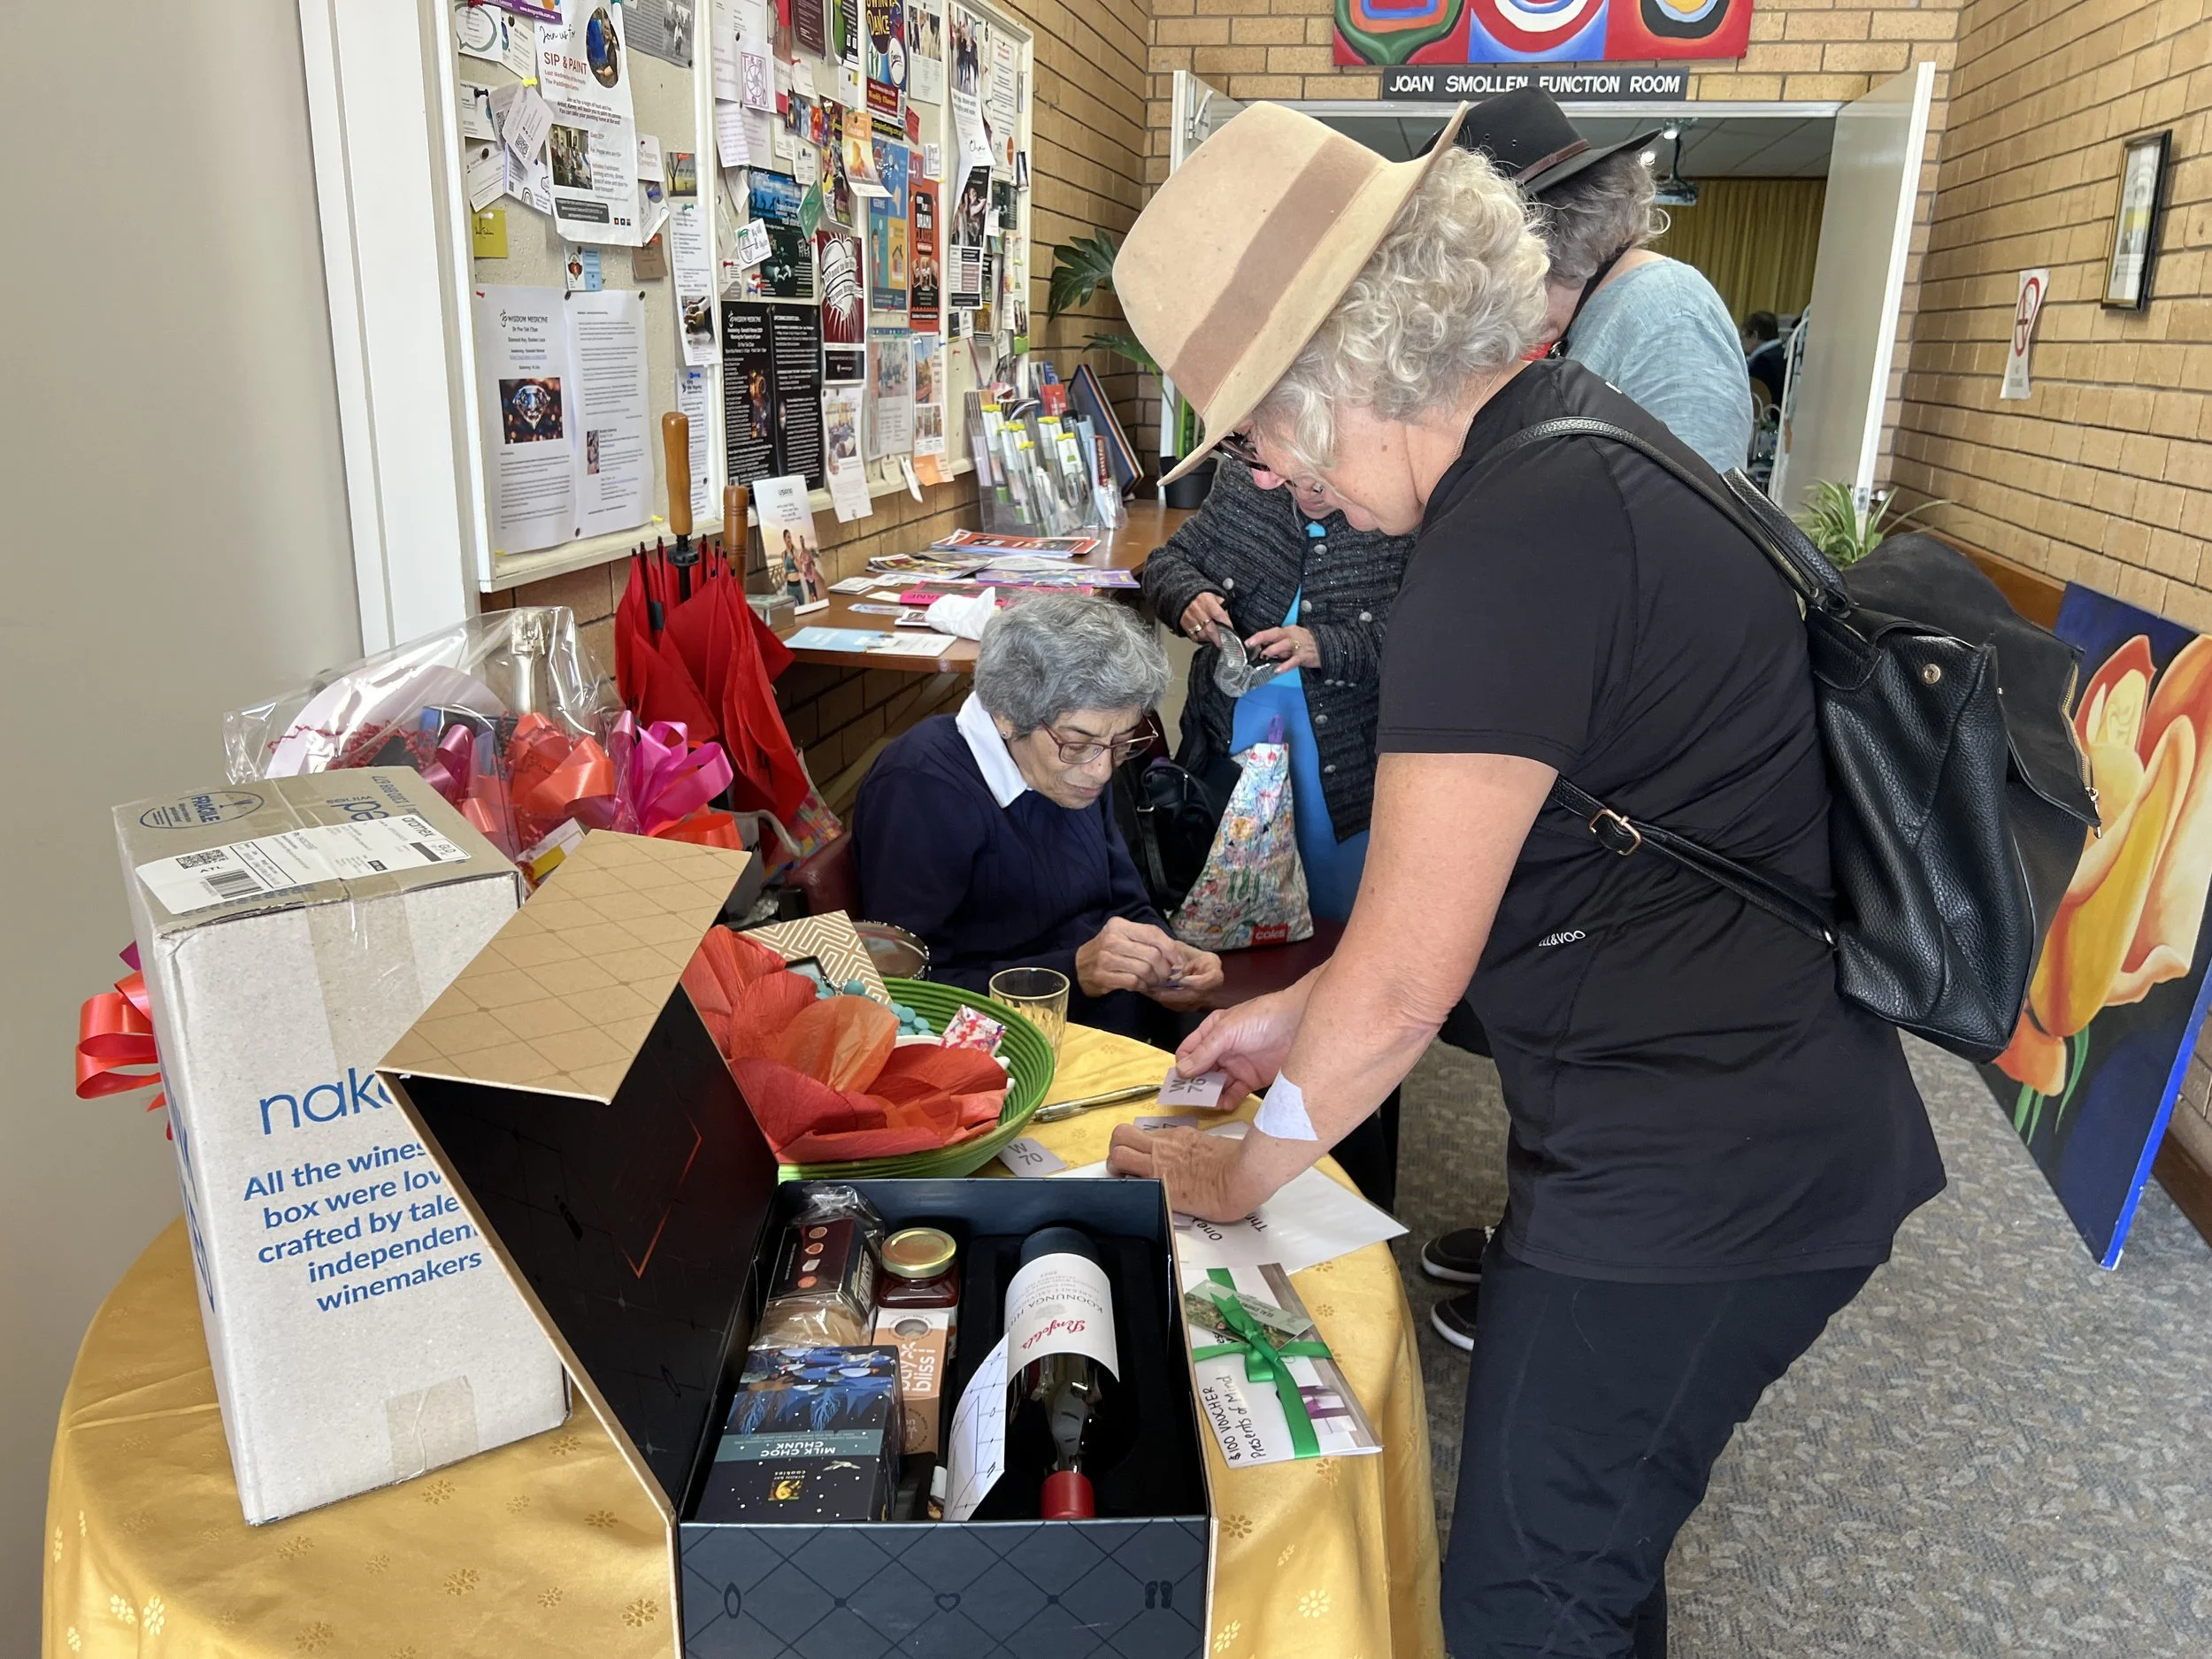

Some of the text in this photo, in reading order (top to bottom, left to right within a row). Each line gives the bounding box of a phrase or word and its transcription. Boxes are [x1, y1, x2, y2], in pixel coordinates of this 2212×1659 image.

[867, 10, 890, 35] DANCE
[543, 51, 588, 74] SIP & PAINT
[1389, 76, 1680, 92] JOAN SMOLLEN FUNCTION ROOM
[191, 793, 221, 823] FRAGILE
[1256, 930, 1285, 941] coles
[1019, 1152, 1042, 1166] 70
[244, 1170, 284, 1202] All
[292, 1161, 342, 1187] the
[264, 1200, 319, 1229] box
[326, 1180, 396, 1212] were
[258, 1217, 361, 1263] crafted
[369, 1210, 403, 1233] by
[317, 1251, 483, 1312] winemakers
[1028, 1294, 1103, 1314] KOONUNGA
[1019, 1319, 1087, 1350] Penfolds
[912, 1357, 935, 1392] bliss
[1216, 1374, 1240, 1402] Mind
[1202, 1386, 1241, 1461] $100 VOUCHER
[1239, 1418, 1267, 1458] Presents
[761, 1445, 835, 1456] MILK CHOC
[775, 1441, 825, 1451] CHUNK
